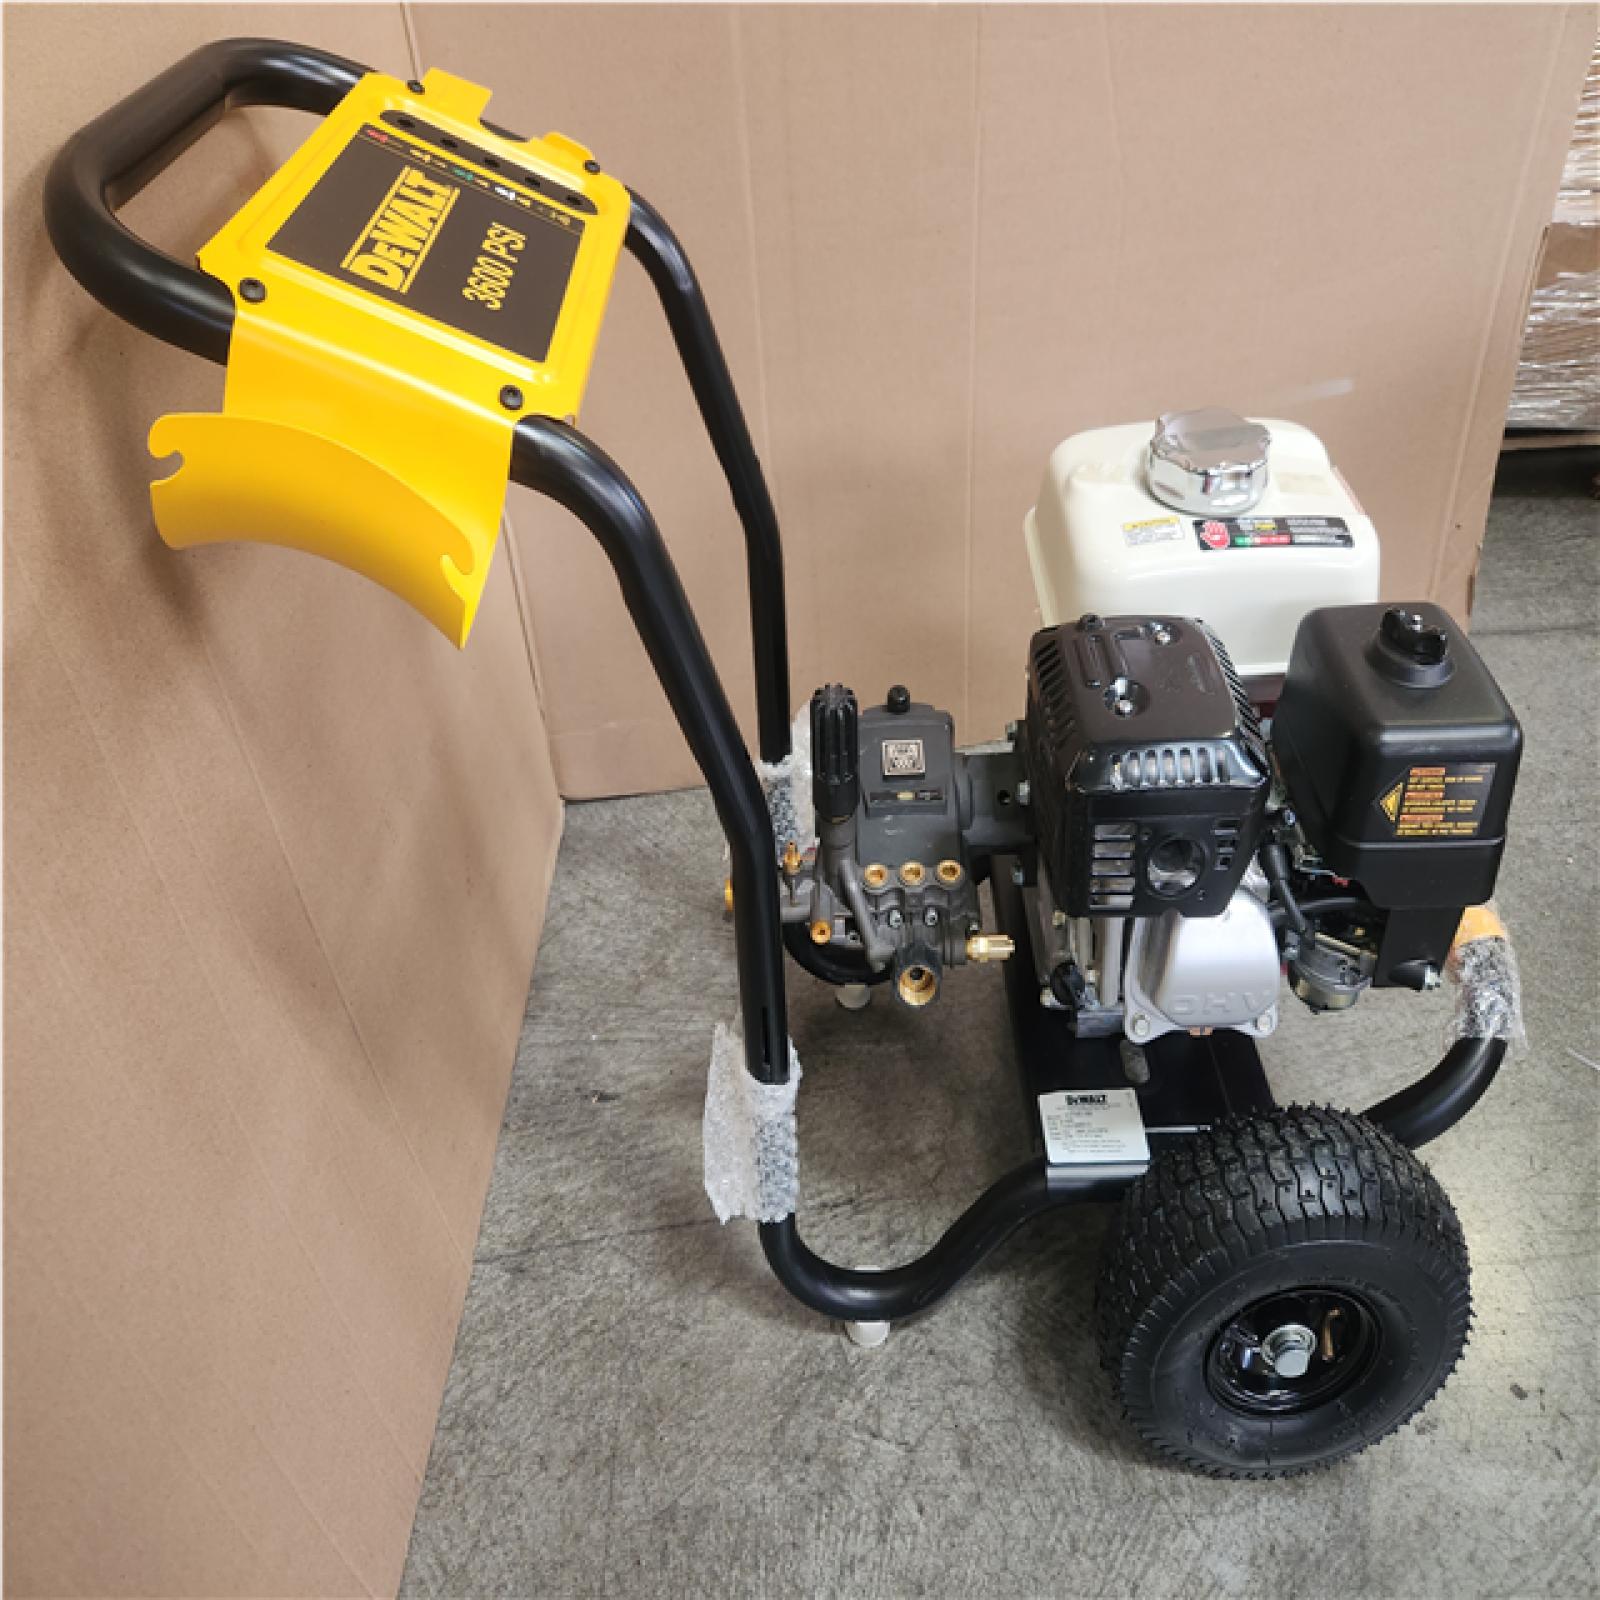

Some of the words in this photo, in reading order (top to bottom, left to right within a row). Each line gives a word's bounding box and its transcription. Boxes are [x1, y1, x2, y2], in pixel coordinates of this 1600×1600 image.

[482, 222, 525, 263] PSI
[462, 255, 513, 310] 3600
[1172, 990, 1272, 1015] OHV
